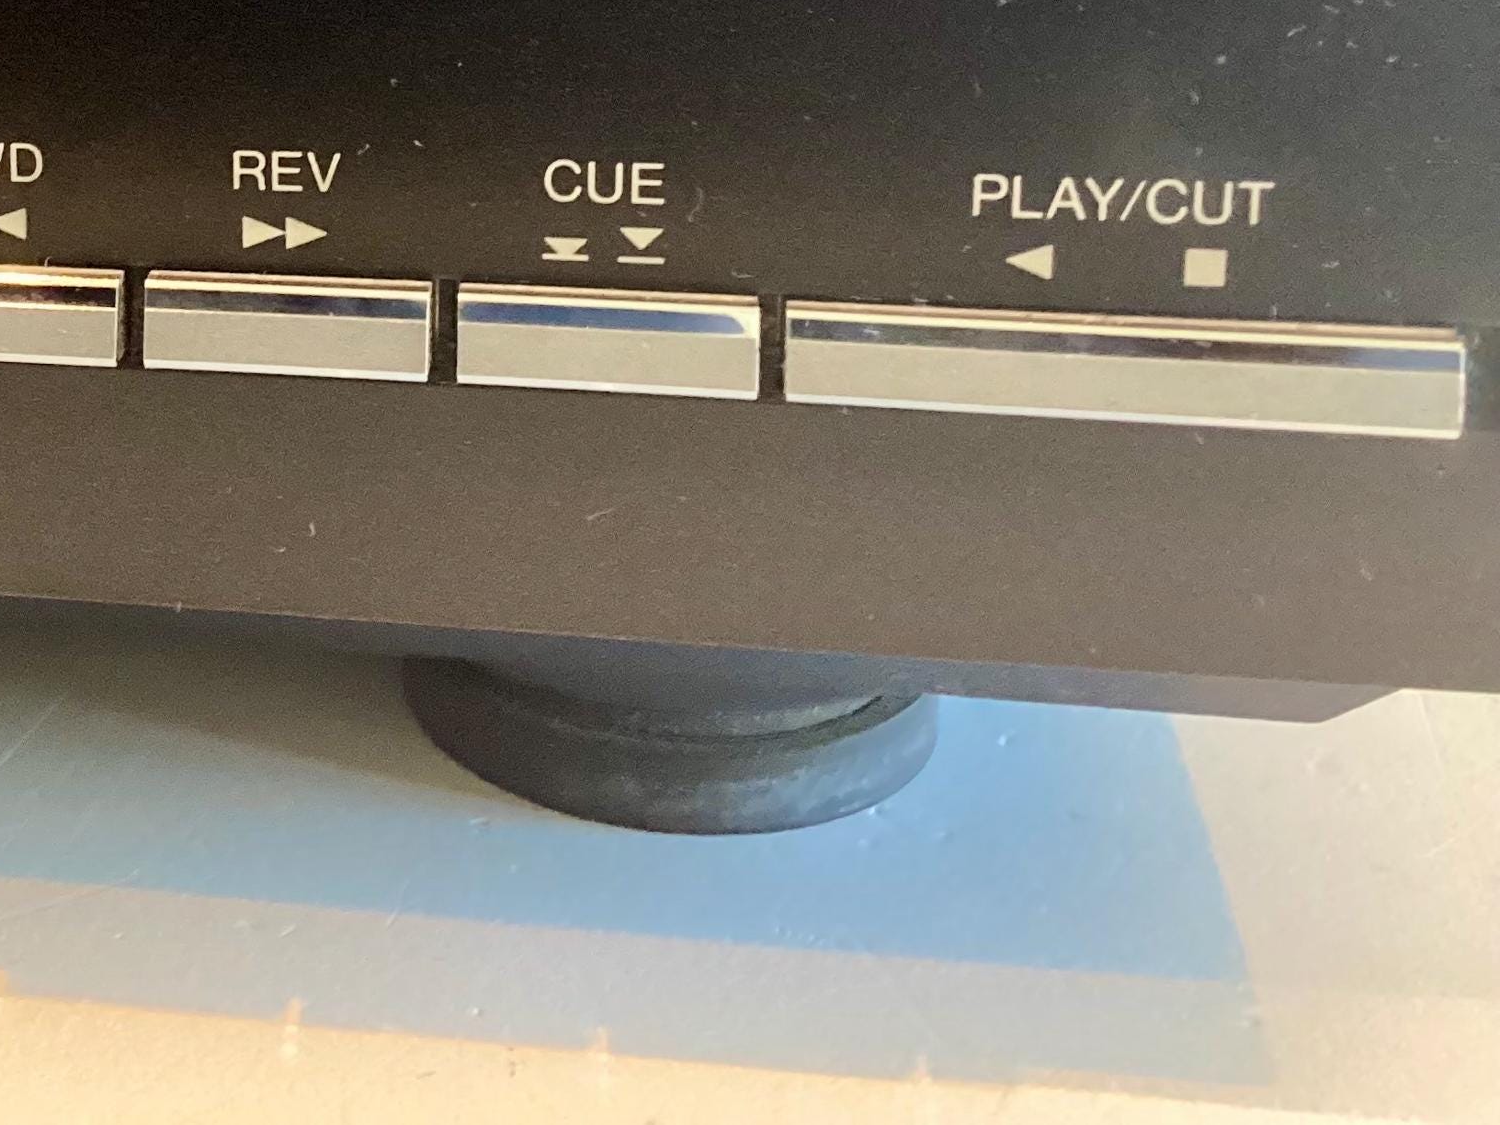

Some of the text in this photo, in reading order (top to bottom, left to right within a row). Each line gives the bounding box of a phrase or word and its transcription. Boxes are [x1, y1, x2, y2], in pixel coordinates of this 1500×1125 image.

[232, 150, 342, 194] REV
[543, 160, 667, 205] CUE
[971, 173, 1277, 226] PLAY/CUT
